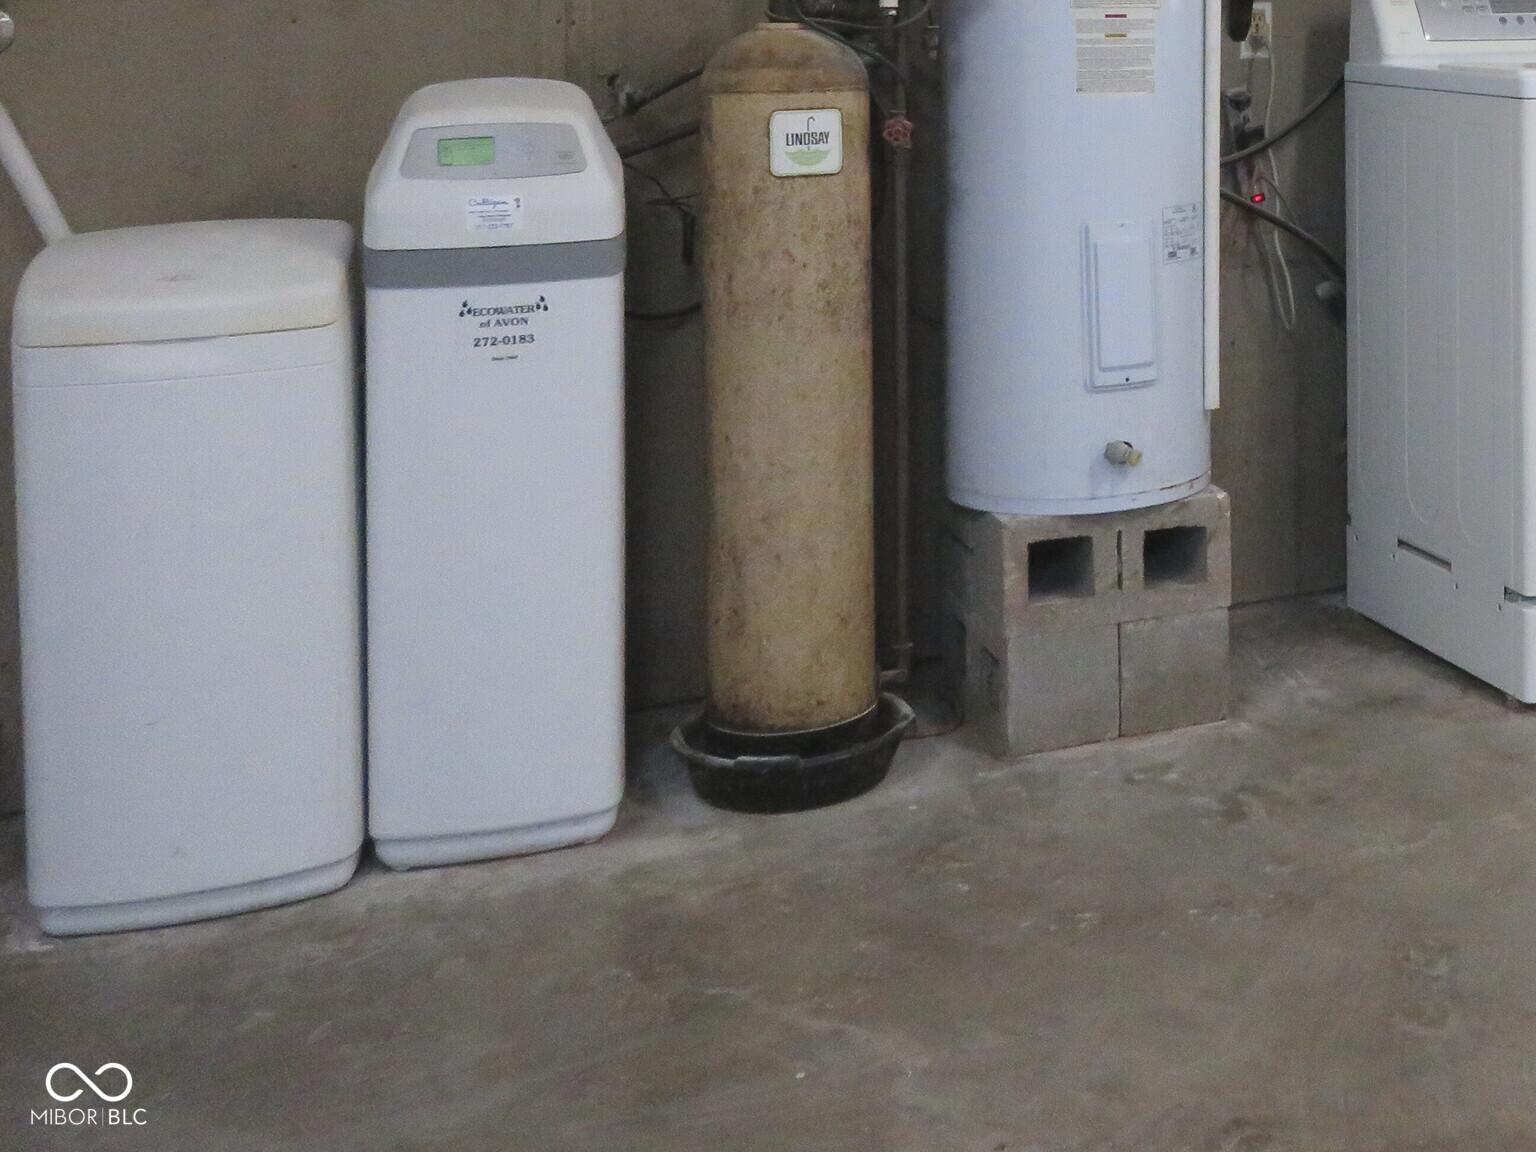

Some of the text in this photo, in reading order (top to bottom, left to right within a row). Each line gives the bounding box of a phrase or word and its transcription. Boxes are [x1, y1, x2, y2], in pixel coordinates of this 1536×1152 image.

[785, 131, 830, 147] LINDSAY
[473, 304, 535, 317] ECOWATER
[493, 316, 529, 328] AVON
[473, 333, 535, 348] 272-0183
